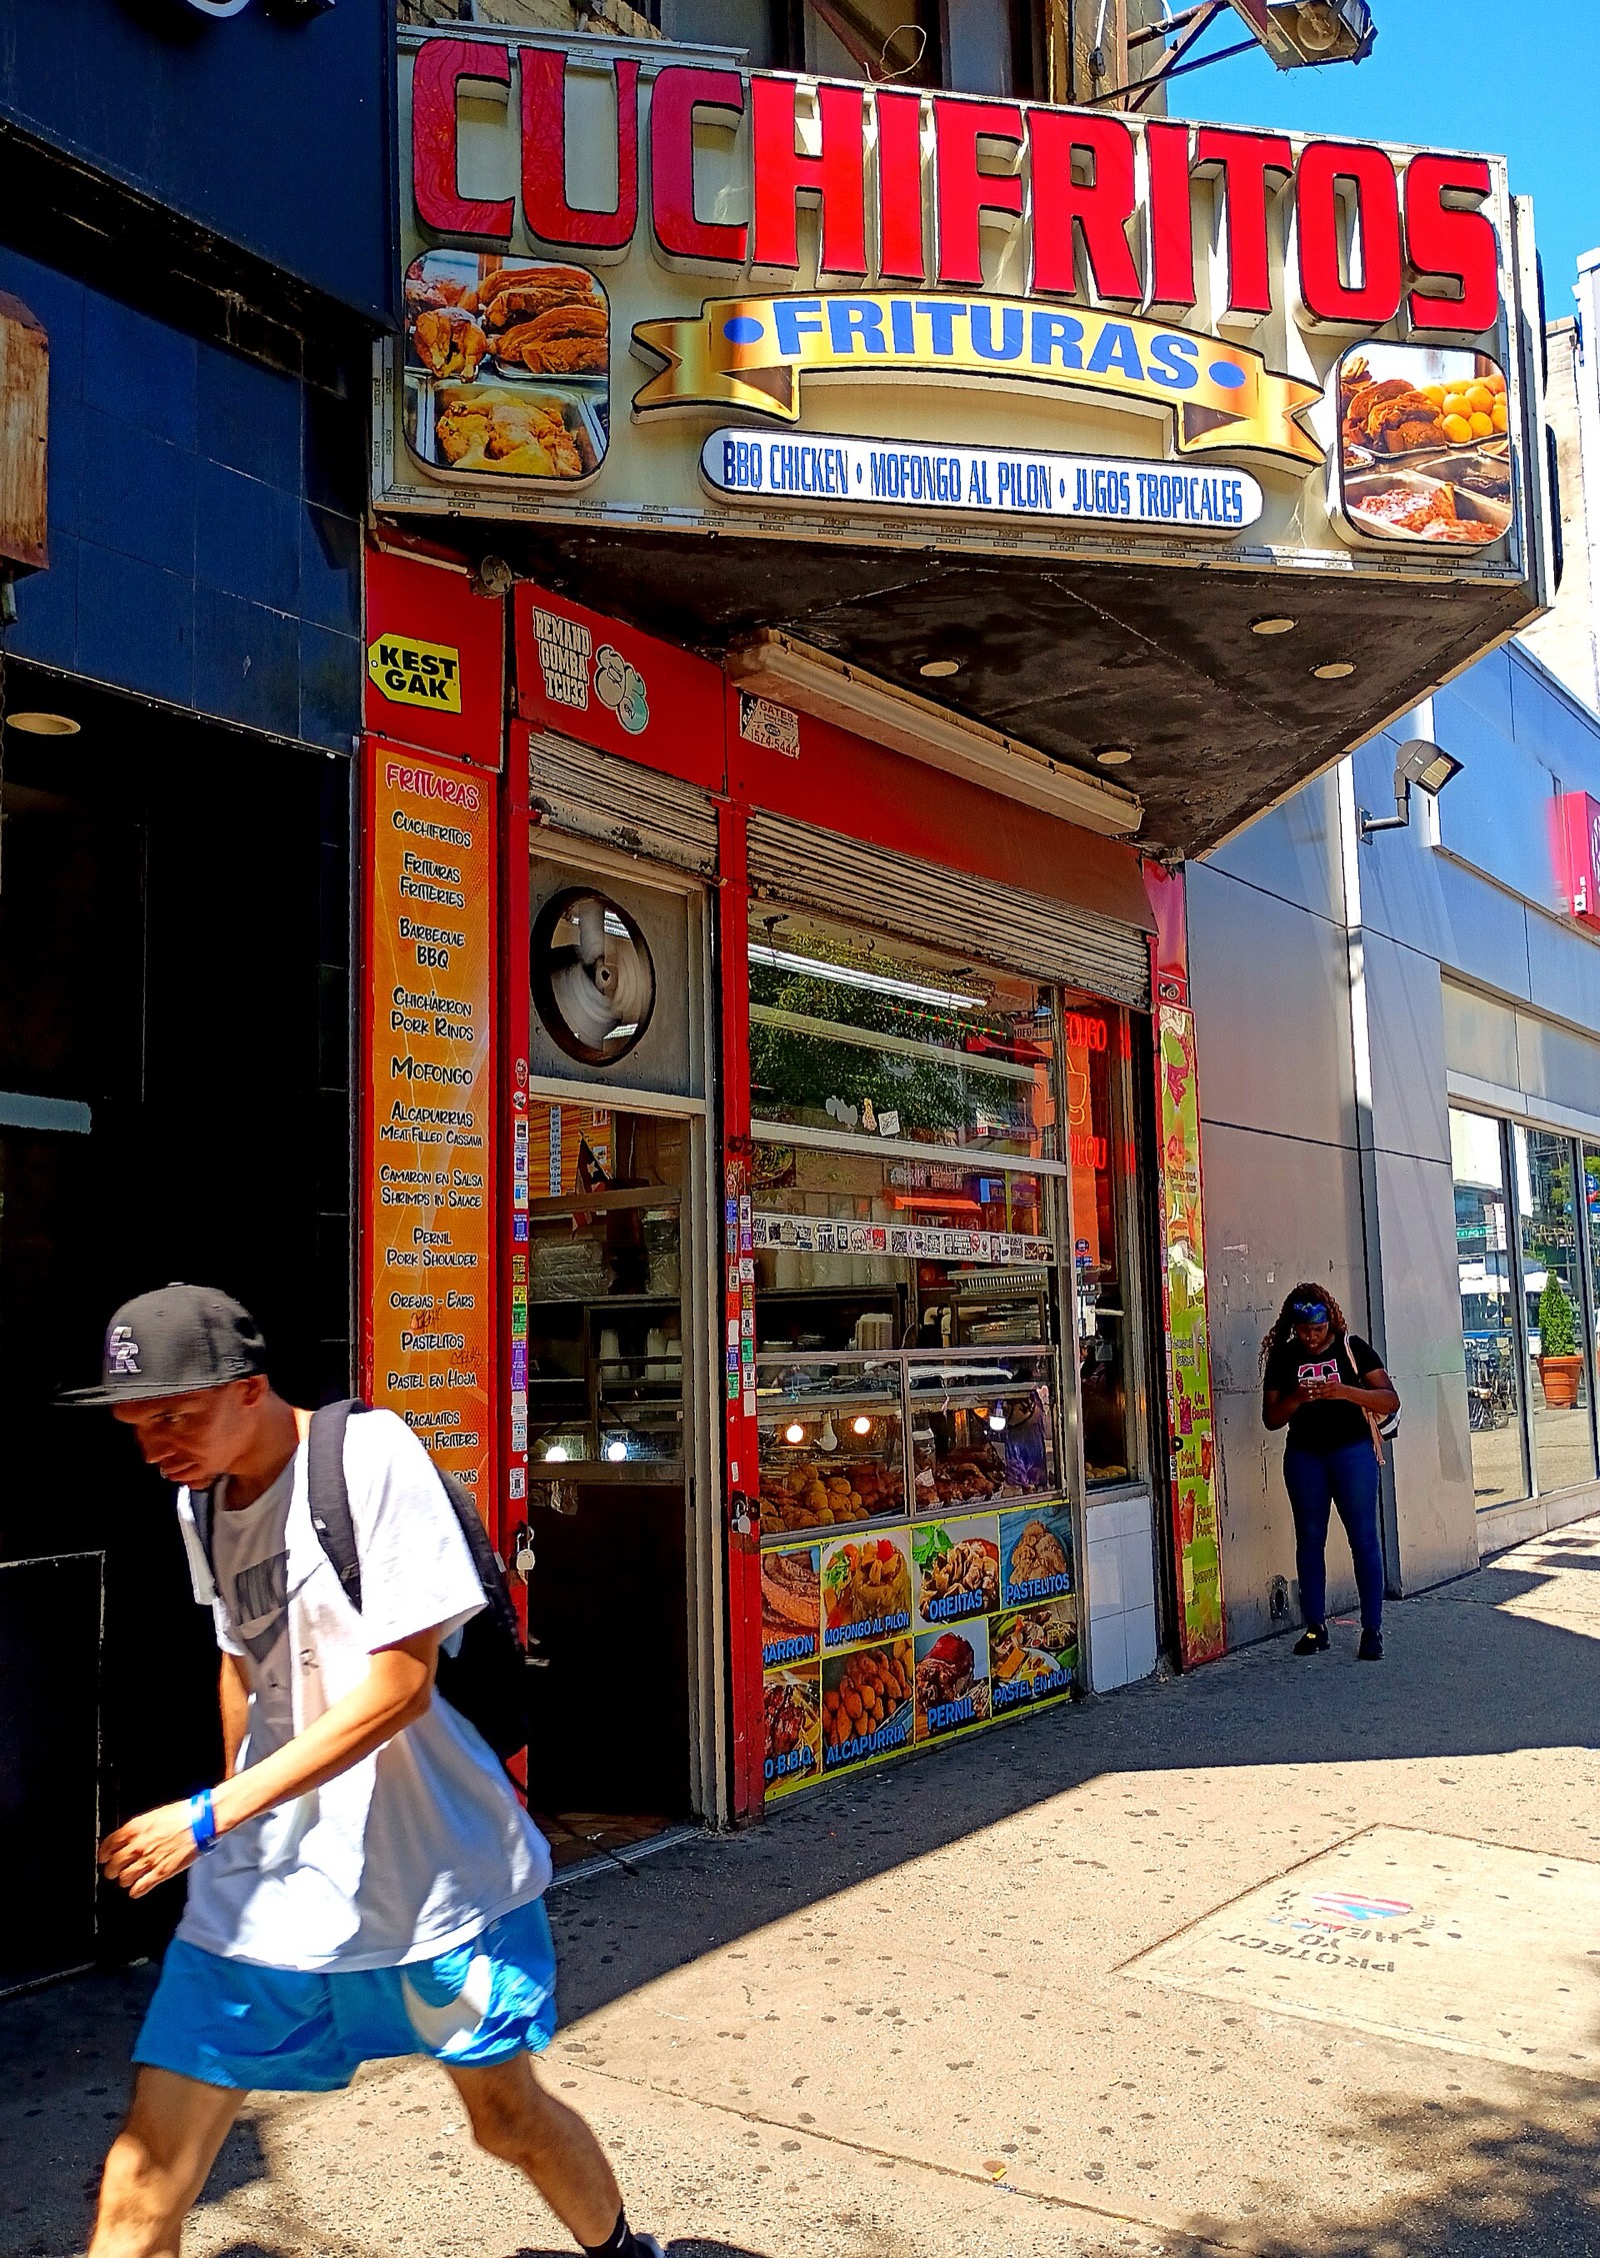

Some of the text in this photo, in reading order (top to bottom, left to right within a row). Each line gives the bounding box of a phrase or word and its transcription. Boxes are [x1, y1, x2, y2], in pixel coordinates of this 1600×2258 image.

[411, 39, 1499, 331] CUCHIFRITOS
[773, 300, 1199, 389] FRITURAS
[723, 440, 1243, 523] BBQ CHICKEN MOFONGO AL PILON JUGOS TROPICALES
[379, 643, 458, 681] KEST
[384, 669, 450, 701] GAK
[760, 700, 796, 726] GATES
[386, 763, 479, 810] FRITURAS
[393, 810, 472, 848] CUCHIFRITOS
[404, 852, 461, 882] FRITURAS
[399, 917, 465, 947] BARBECUE
[416, 945, 450, 970] BBQ
[391, 1009, 474, 1041] PORK RINDS
[391, 1054, 473, 1085] MOFONGO
[391, 1099, 475, 1128] ALCAPURRIAS
[446, 1130, 482, 1148] CASSAVA
[380, 1165, 483, 1189] CAMARON EN SALSA
[381, 1187, 482, 1209] SHRIMPS IN SAUCE
[413, 1228, 453, 1246] PERNIL
[386, 1248, 477, 1268] PORK SHOULDER
[389, 1289, 434, 1310] OREJAS
[446, 1289, 475, 1309] EARS
[401, 1331, 464, 1352] PASTELITOS
[387, 1368, 478, 1391] PASTEL EN HOJA
[404, 1410, 461, 1428] BACALAITOS
[1005, 1573, 1070, 1602] PASTELITOS
[929, 1589, 983, 1620] OREJITAS
[825, 1611, 910, 1646] MOFONGO AL PILON
[993, 1667, 1074, 1706] PASTEL EN HOJA
[928, 1697, 976, 1730] PERNIL
[826, 1725, 907, 1765] ALCAPURRIA
[1218, 1934, 1395, 1973] PROTECT
